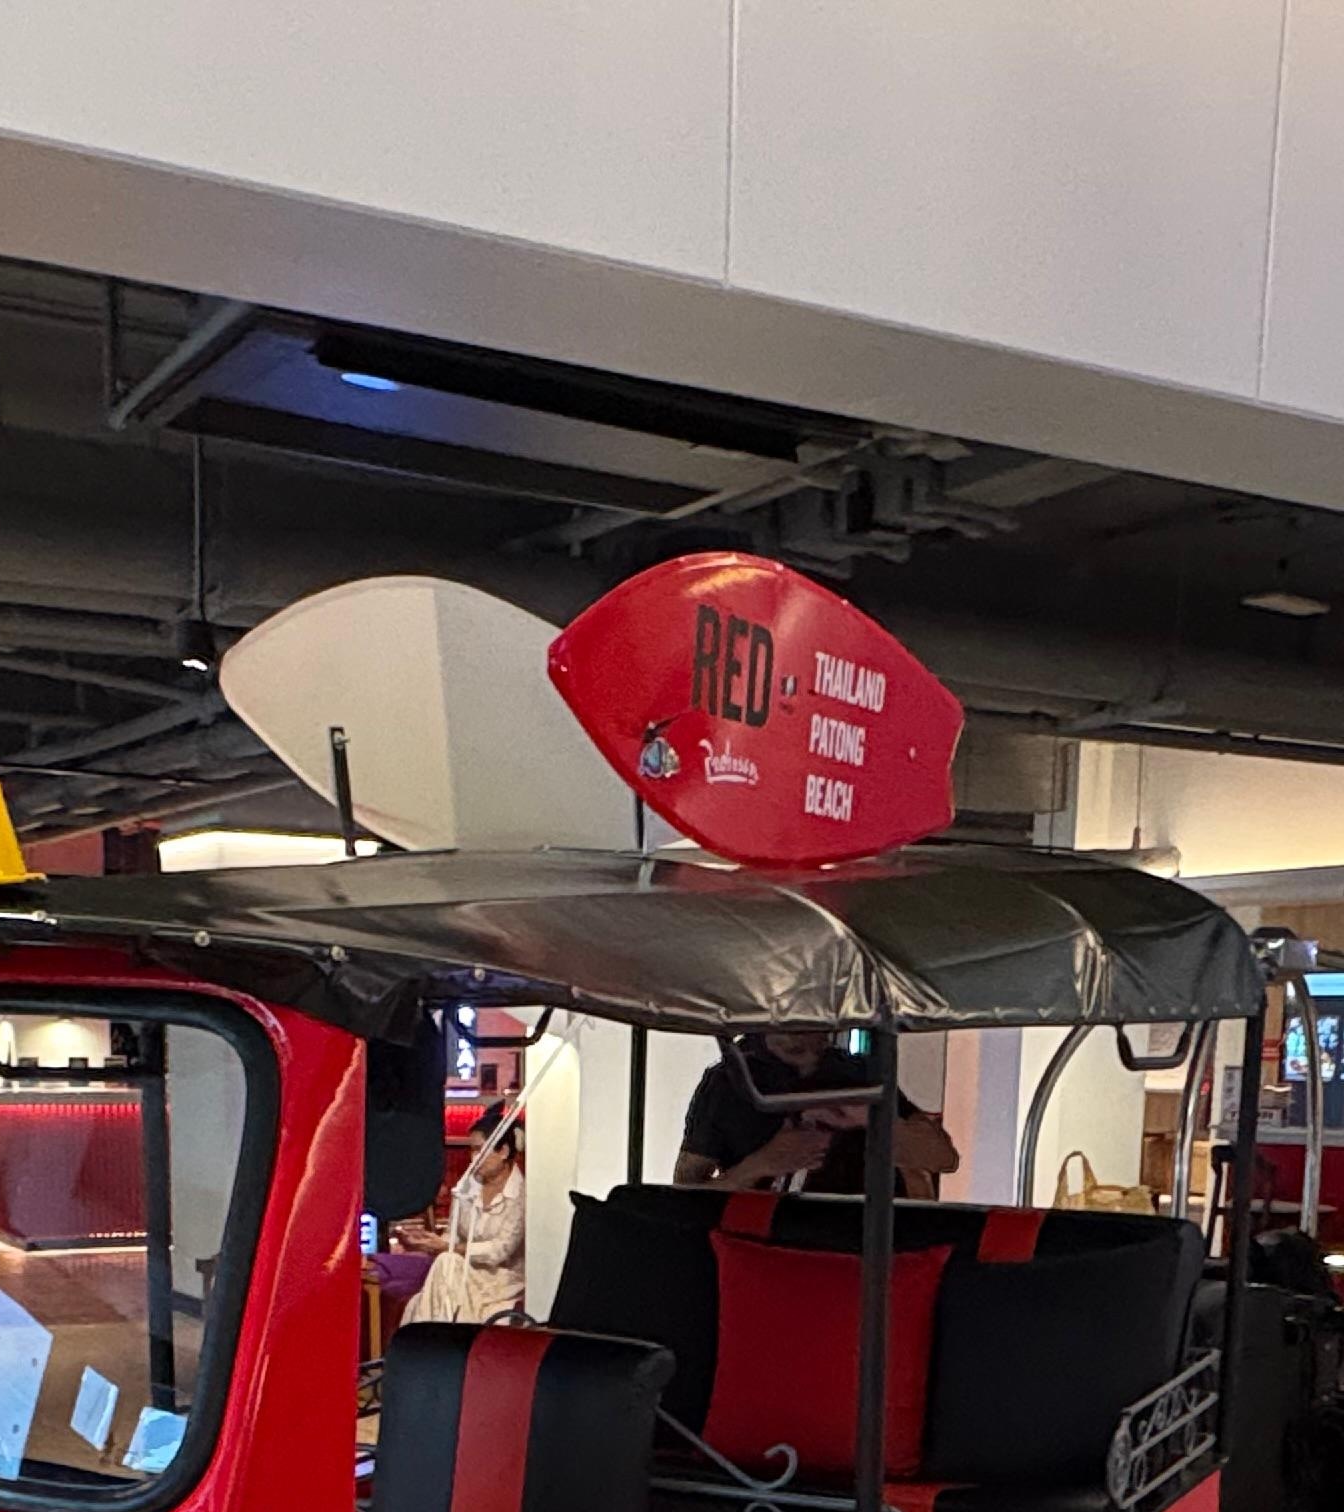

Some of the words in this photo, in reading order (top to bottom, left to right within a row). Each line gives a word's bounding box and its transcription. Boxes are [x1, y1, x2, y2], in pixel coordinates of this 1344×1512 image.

[691, 604, 775, 729] RED
[814, 651, 887, 714] THAILAND
[809, 713, 865, 767] PATONG
[804, 774, 854, 822] BEACH
